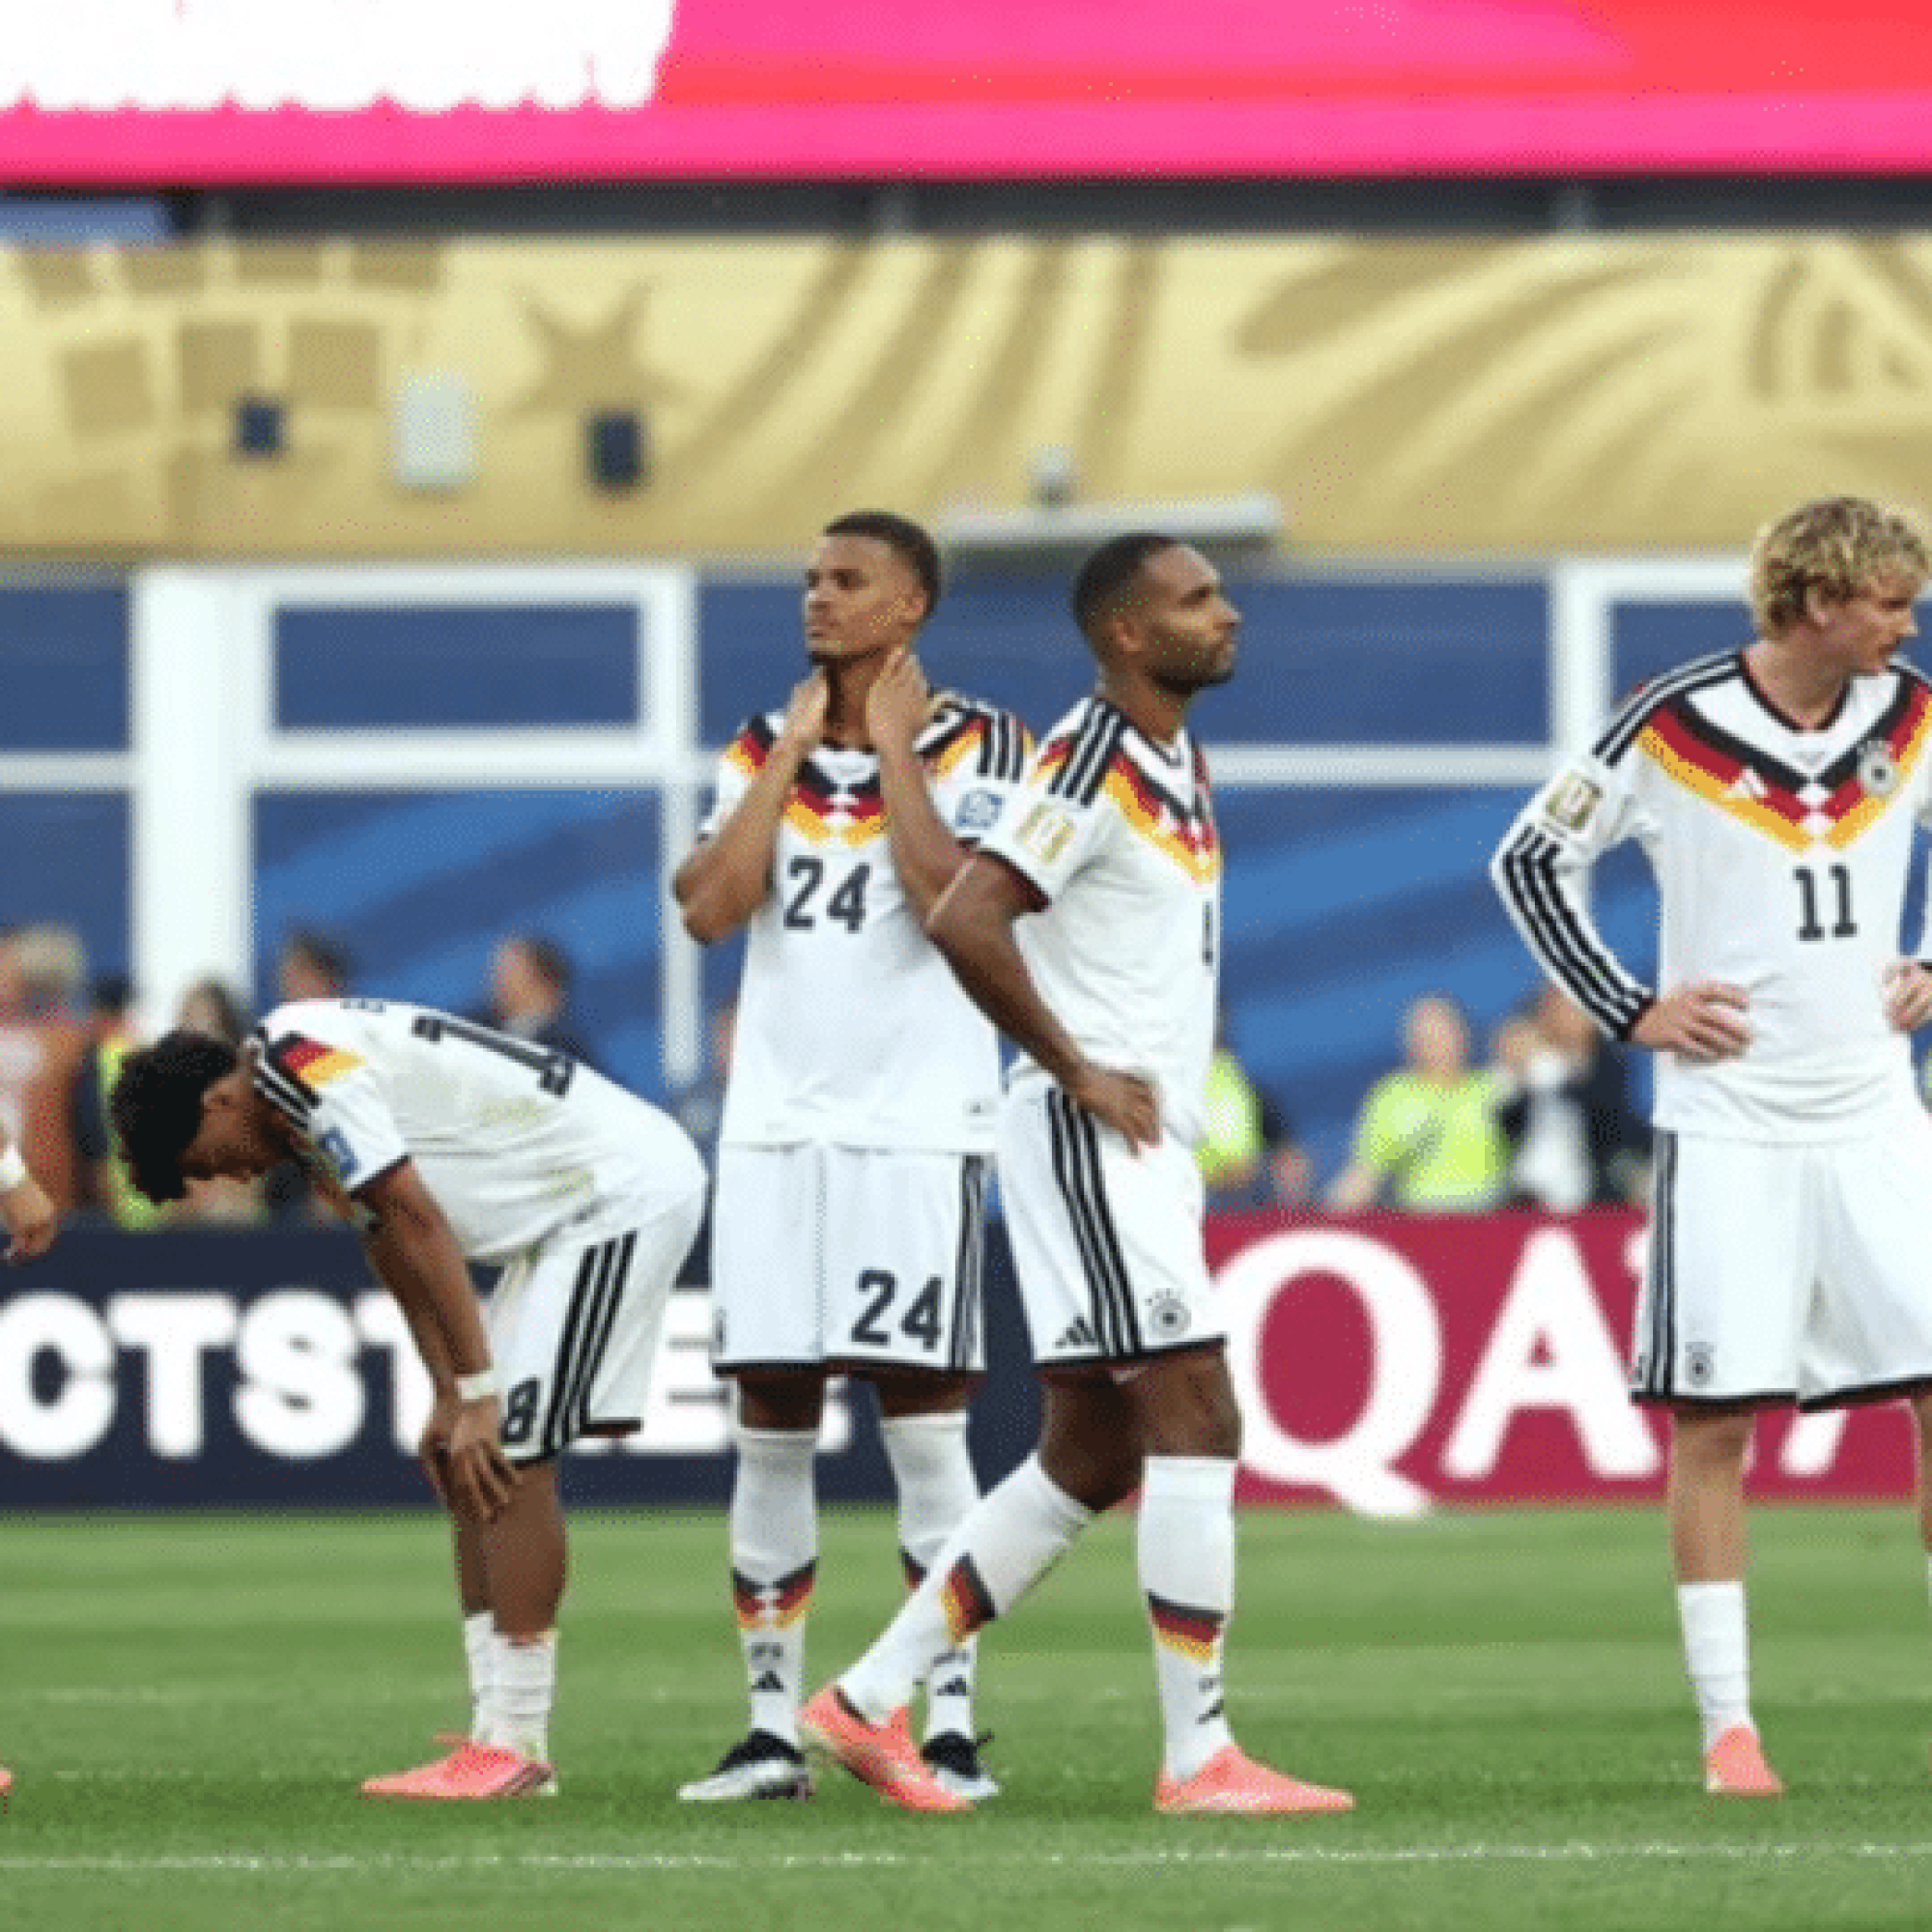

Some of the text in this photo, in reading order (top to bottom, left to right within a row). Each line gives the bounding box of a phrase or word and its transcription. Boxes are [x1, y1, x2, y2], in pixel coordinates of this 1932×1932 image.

[781, 855, 871, 934] 24
[1793, 863, 1860, 942] 11
[850, 1267, 945, 1352] 24
